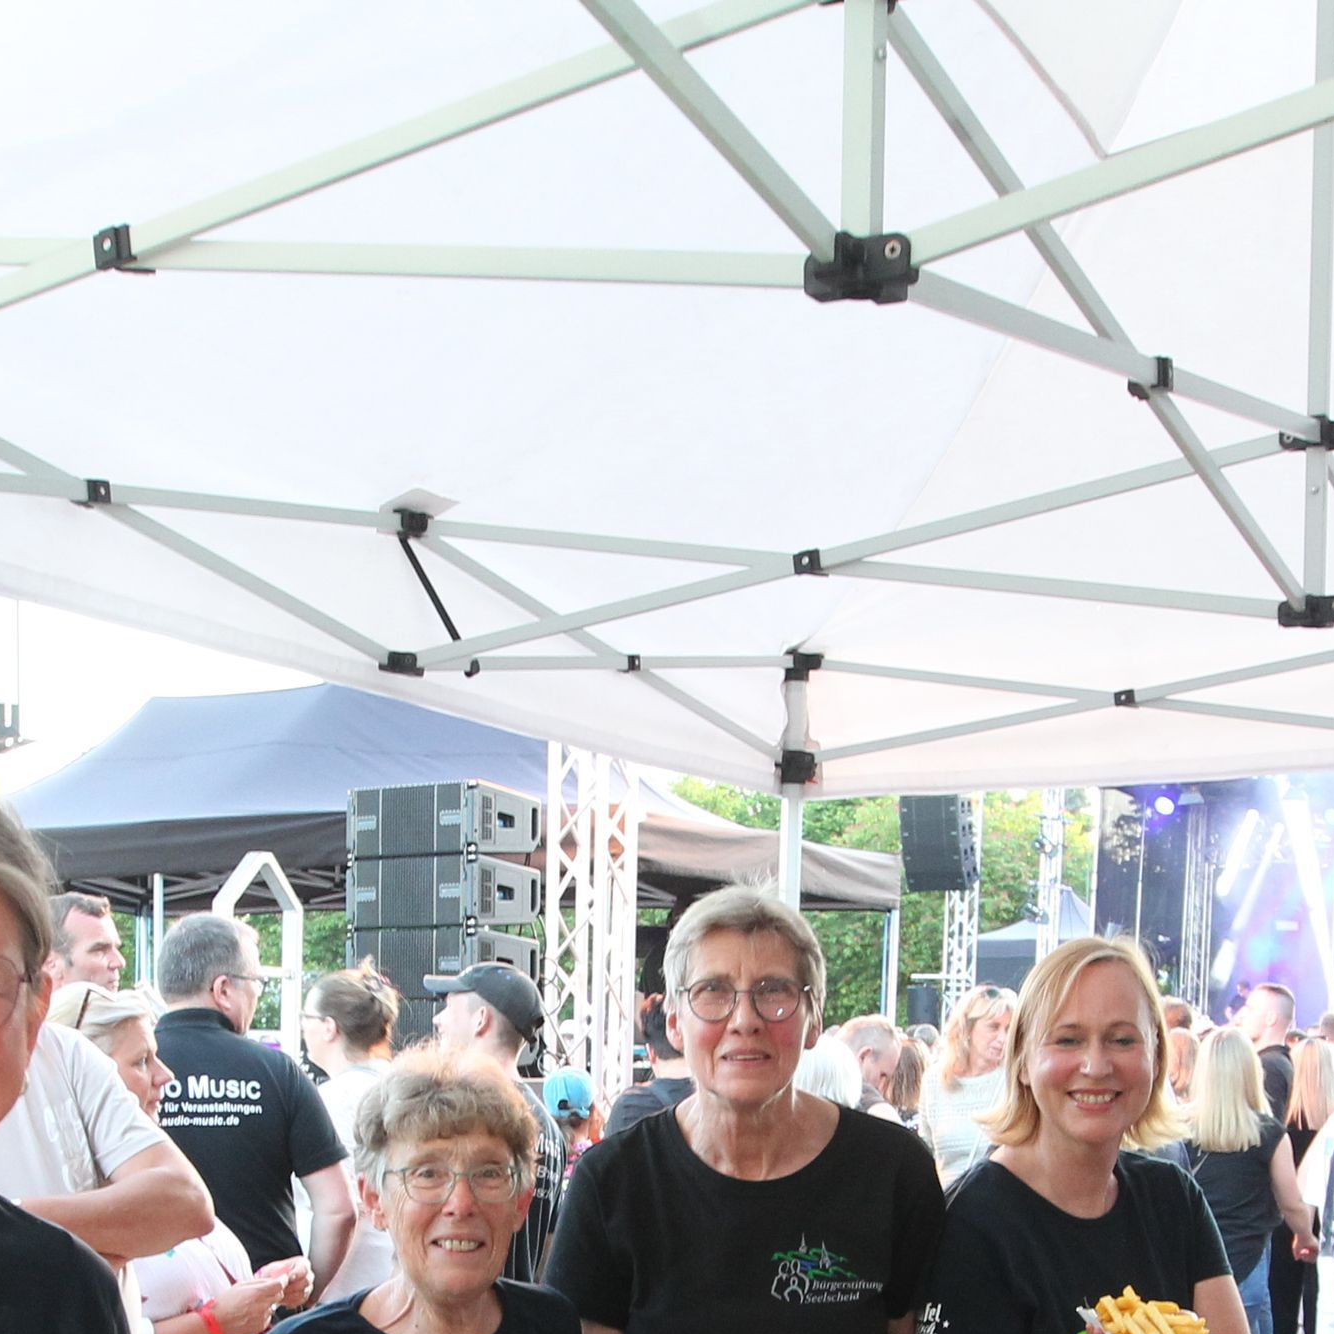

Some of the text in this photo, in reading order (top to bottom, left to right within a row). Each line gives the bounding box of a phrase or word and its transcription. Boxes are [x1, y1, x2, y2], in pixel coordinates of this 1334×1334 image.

[164, 1101, 179, 1114] für
[180, 1101, 262, 1116] Veranstaltungen
[812, 1279, 883, 1294] Bürgerstiftung
[805, 1291, 860, 1304] Seelscheid
